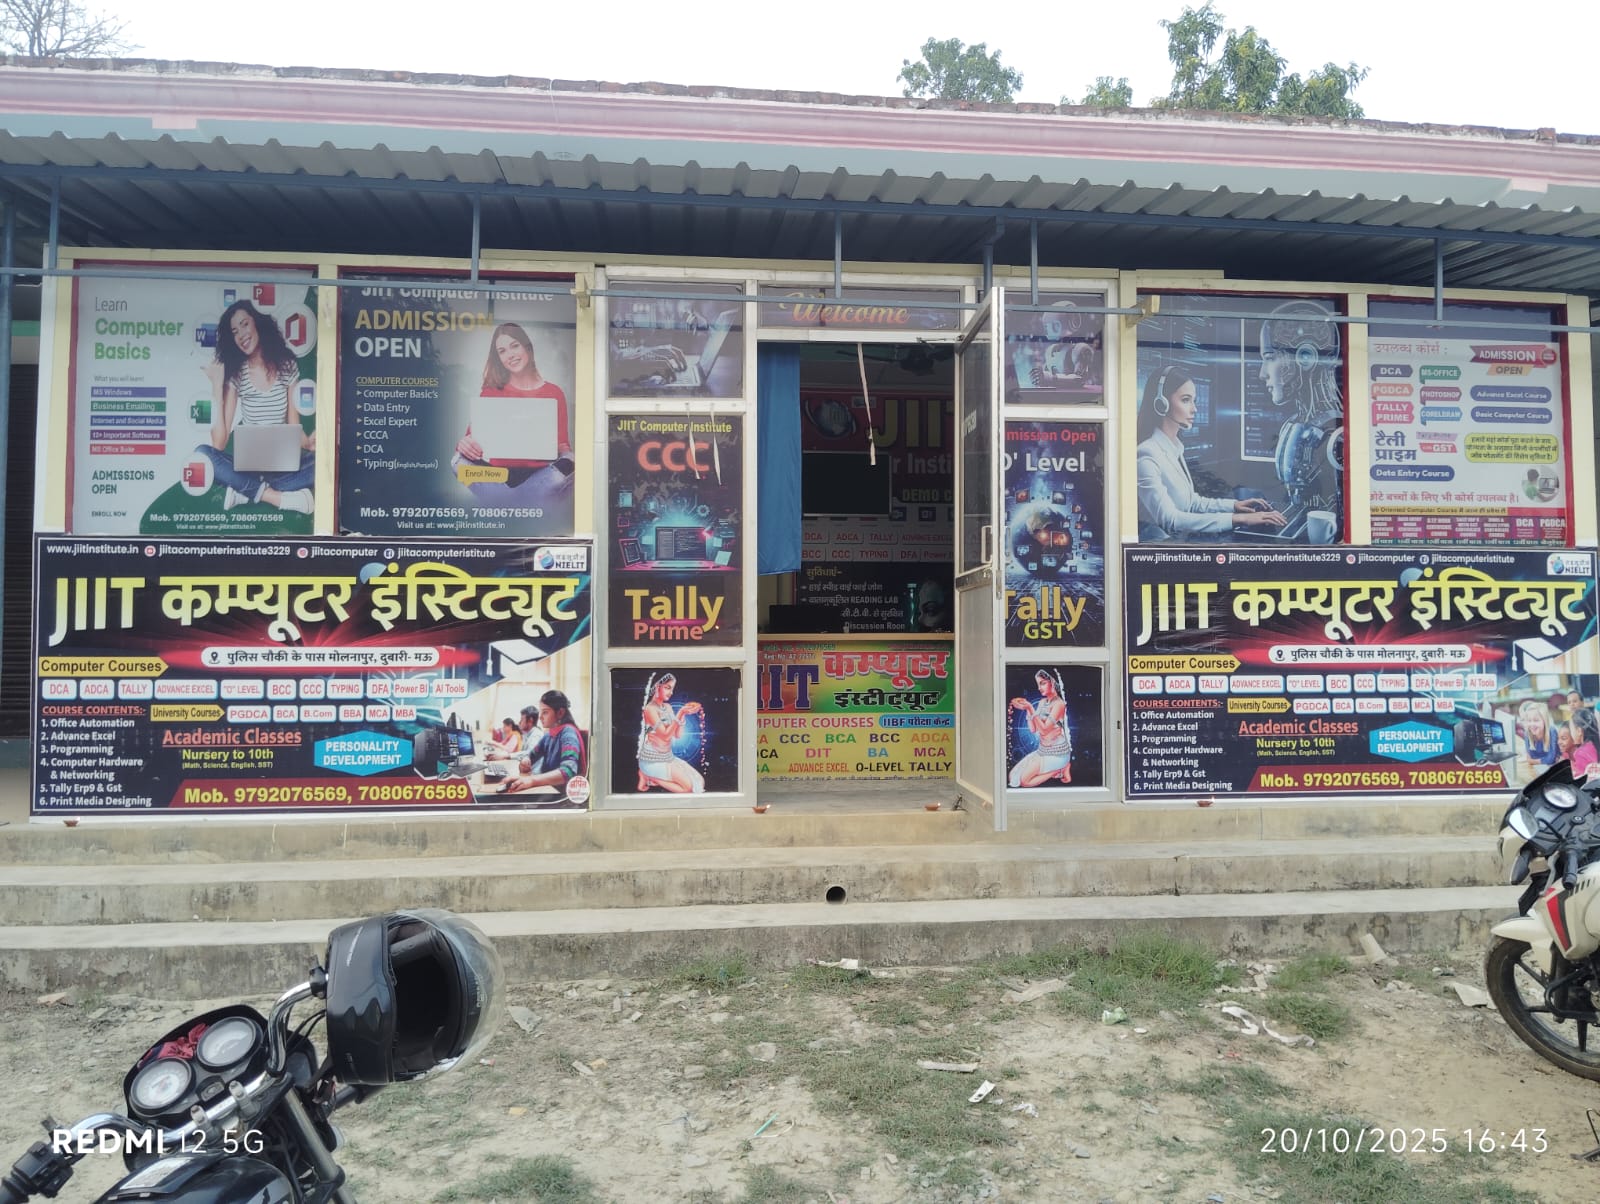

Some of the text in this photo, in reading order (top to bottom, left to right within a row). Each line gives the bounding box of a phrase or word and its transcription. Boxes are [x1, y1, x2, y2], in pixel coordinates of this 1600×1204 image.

[95, 297, 128, 312] Learn
[355, 309, 494, 332] ADMISSION
[95, 318, 184, 338] Computer
[94, 342, 150, 360] Basics
[355, 336, 421, 358] OPEN
[1480, 350, 1536, 362] ADMISSION
[1496, 366, 1522, 375] OPEN
[356, 376, 438, 386] COMPUTER COURSES
[364, 390, 438, 399] Computer Basic's
[364, 403, 410, 413] Data Entry
[364, 417, 417, 428] Excel Expert
[617, 420, 732, 434] JIIT Computer Institute
[364, 431, 388, 440] CCCA
[1006, 430, 1096, 445] mission Open
[1375, 430, 1405, 446] टैली
[364, 445, 384, 454] DCA
[638, 441, 710, 472] CCC
[1375, 449, 1417, 462] प्राइम
[1026, 452, 1085, 472] Level
[92, 470, 154, 480] ADMISSIONS
[92, 484, 117, 494] OPEN
[150, 513, 171, 522] Mob.
[360, 508, 543, 519] Mob. 9792076569, 7080676569
[47, 544, 495, 558] www.jiitinstitute.in jiitacomputerinstitute3229 jiitacomputer jiitacomputeristitute
[1132, 554, 1515, 564] www.jiitinstitute.in jiitacomputerinstitute3229 jiitacomputer jiitacomputeristitute
[48, 561, 579, 646] JIIT कम्प्यूटर इंस्टिट्यूट
[1006, 586, 1086, 631] Tally
[1136, 567, 1586, 646] JIIT कम्प्यूटर इंस्टिट्यूट
[624, 586, 724, 632] Tally
[634, 620, 703, 640] Prime
[1024, 622, 1066, 640] GST
[227, 652, 258, 665] पुलिस
[261, 650, 288, 662] चौकी
[291, 650, 302, 662] के
[304, 653, 325, 662] पास
[414, 652, 433, 662] मऊ
[41, 660, 162, 674] Computer Courses
[822, 651, 950, 690] कम्प्यूटर
[50, 684, 69, 694] DCA
[84, 684, 109, 694] ADCA
[122, 684, 147, 694] TALLY
[157, 684, 214, 694] ADVANCE EXCEL
[237, 684, 261, 694] LEVEL
[272, 684, 292, 695] BCC
[303, 684, 322, 694] CCC
[331, 684, 359, 694] TYPING
[372, 684, 388, 694] DFA
[394, 684, 427, 693] Power BI
[436, 684, 465, 693] AI Tools
[42, 706, 147, 715] COURSE CONTENTS:-
[152, 707, 221, 720] University Courses
[230, 710, 268, 718] PGDCA
[276, 710, 295, 718] BCA
[304, 710, 333, 718] B.Com
[344, 709, 361, 718] BBA
[369, 709, 388, 718] MCA
[395, 709, 414, 718] MBA
[42, 718, 135, 728] 1. Office Automation
[811, 717, 874, 728] COURSES
[883, 718, 906, 727] IIBF
[41, 731, 115, 741] 2. Advance Excel
[162, 728, 302, 745] Academic Classes
[779, 734, 810, 744] CCC
[825, 734, 856, 743] BCA
[869, 733, 900, 743] BCC
[911, 733, 950, 742] ADCA
[1379, 731, 1442, 740] PERSONALITY
[41, 744, 114, 756] 3. Programming
[326, 741, 399, 752] PERSONALITY
[1378, 743, 1445, 753] DEVELOPMENT
[182, 749, 273, 762] Nursery to 10th
[805, 748, 832, 758] DIT
[868, 748, 889, 758] BA
[914, 747, 946, 757] MCA
[40, 757, 143, 769] 4. Computer Hardware
[323, 754, 401, 765] DEVELOPMENT
[789, 763, 849, 773] ADVANCE EXCEL
[856, 762, 904, 772] O-LEVEL
[909, 762, 952, 771] TALLY
[50, 770, 115, 782] & Networking
[1260, 770, 1502, 788] Mob. 9792076569, 7080676569
[40, 783, 122, 795] 5. Tally Erp9 & Gst
[184, 785, 467, 804] Mob. 9792076569, 7080676569
[40, 796, 152, 807] 6. Print Media Designing
